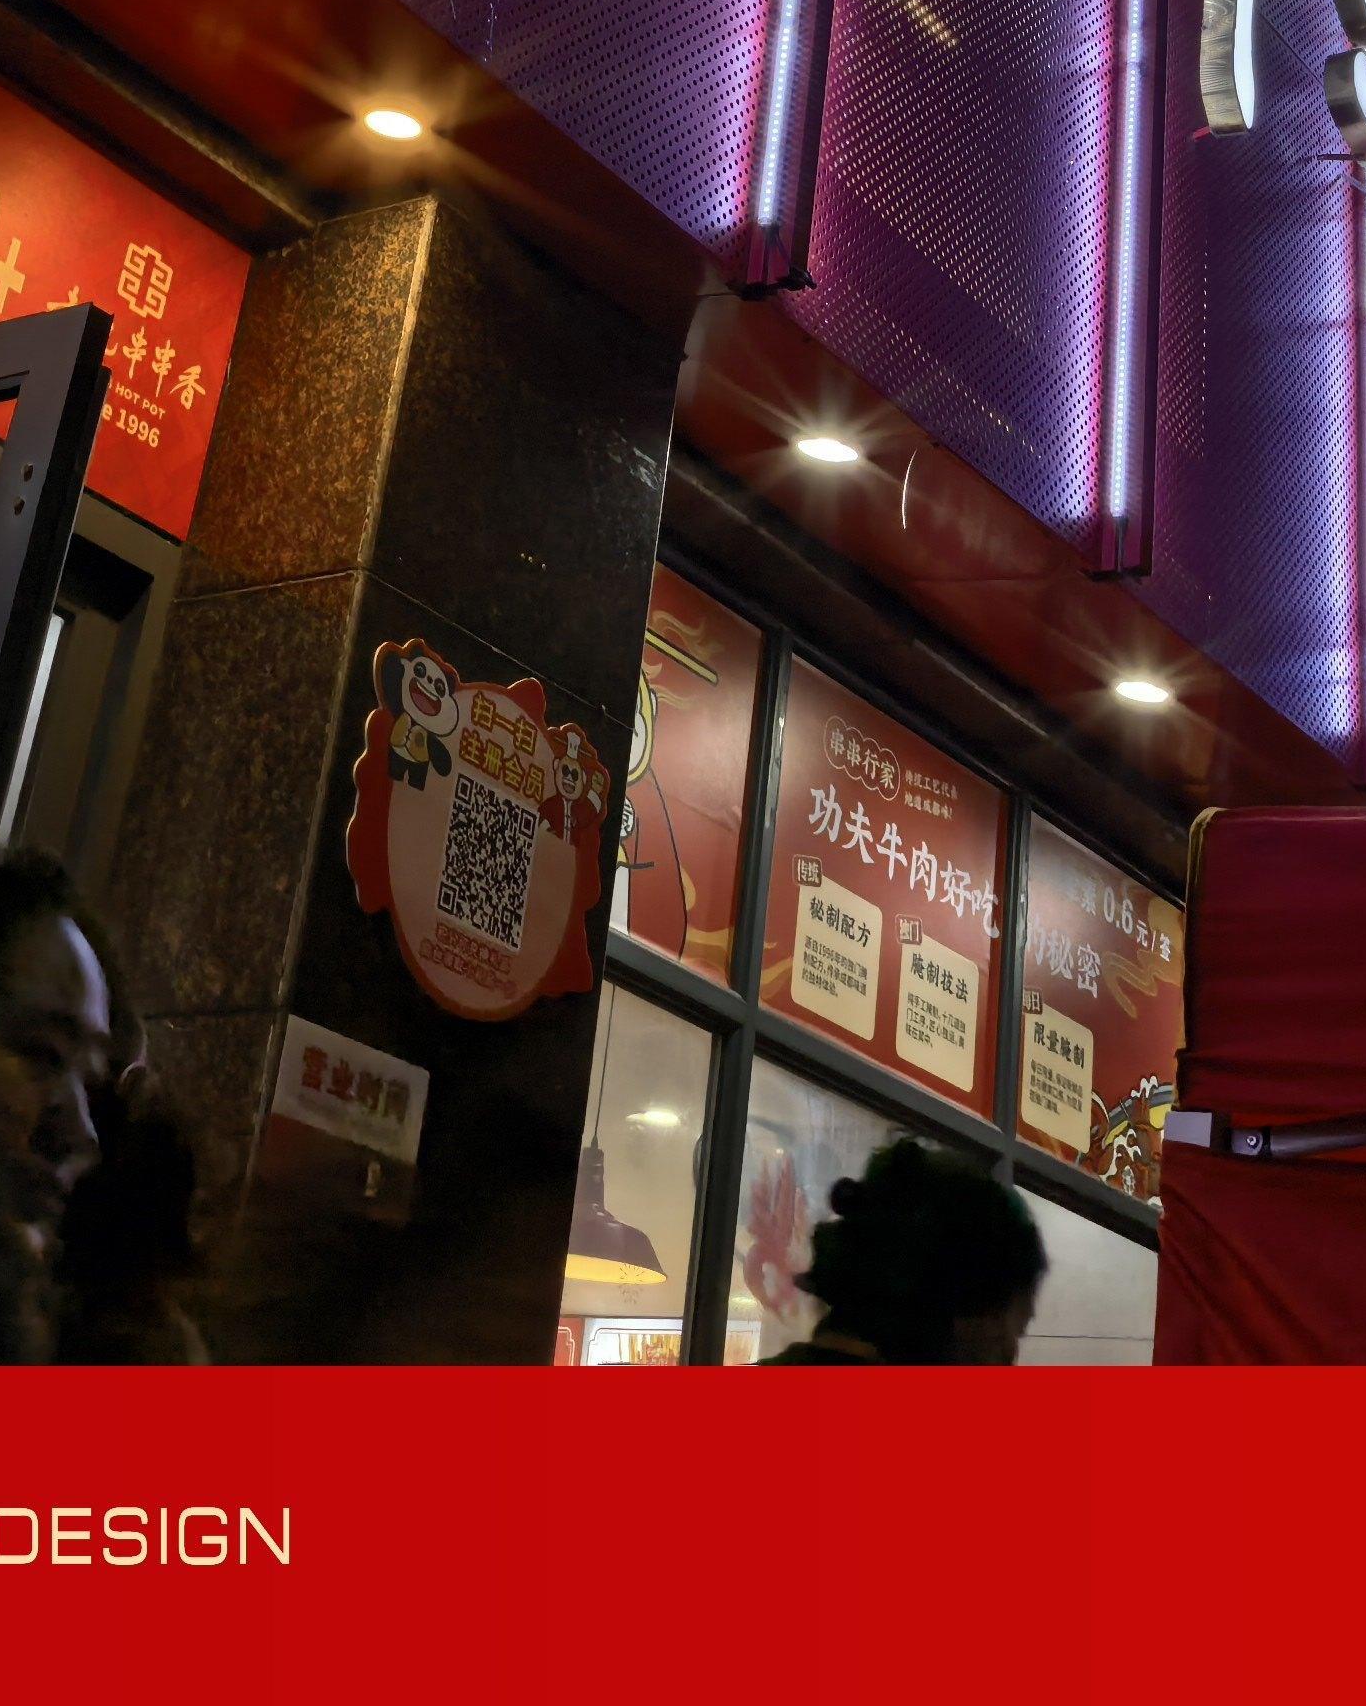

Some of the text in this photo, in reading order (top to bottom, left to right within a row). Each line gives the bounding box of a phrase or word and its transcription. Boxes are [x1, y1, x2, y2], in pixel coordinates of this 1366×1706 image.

[115, 382, 140, 405] HOT
[142, 398, 166, 420] POT
[116, 408, 161, 448] 1996
[471, 690, 538, 756] 扫一扫
[459, 727, 546, 805] 注册会员
[829, 729, 896, 790] 串串行家
[808, 783, 1001, 939] 功夫牛肉好吃
[809, 896, 871, 948] 秘制配方
[910, 953, 969, 1004] 腌制技法
